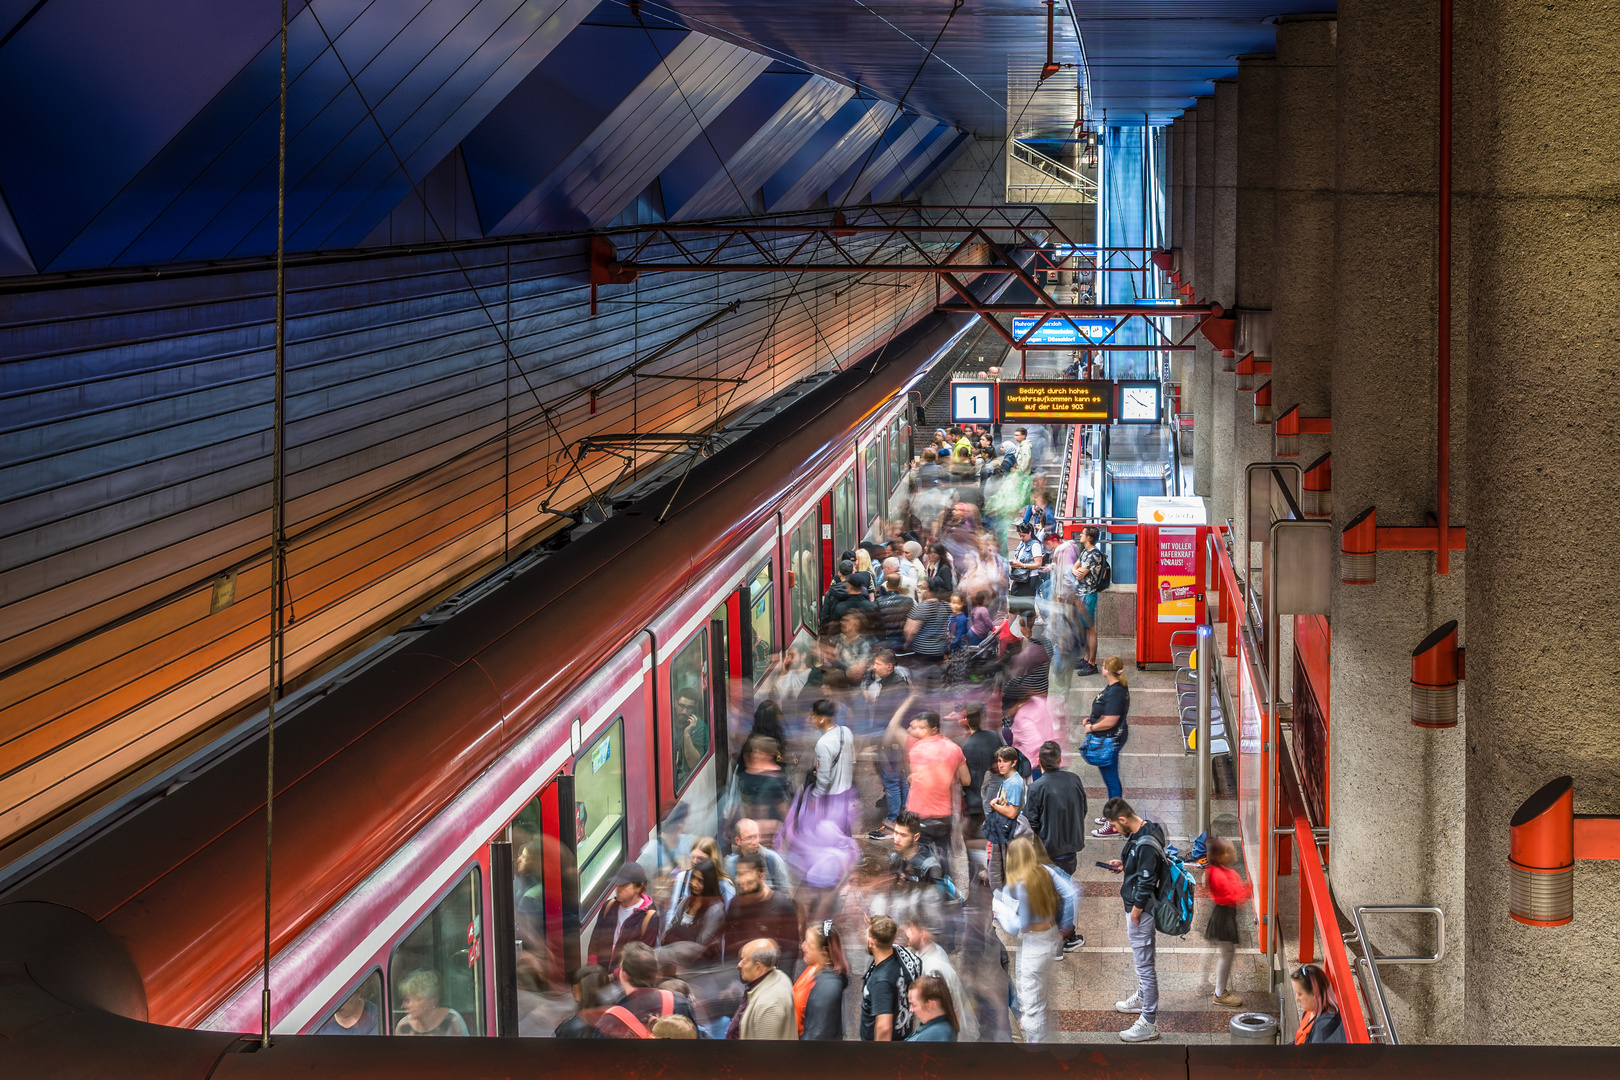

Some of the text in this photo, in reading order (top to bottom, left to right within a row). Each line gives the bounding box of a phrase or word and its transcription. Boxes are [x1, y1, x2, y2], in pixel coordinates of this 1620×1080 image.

[1019, 387, 1045, 395] Bedingt
[1007, 395, 1073, 403] Verkehrsaufkommen
[969, 395, 977, 414] 1
[1024, 403, 1036, 411] auf
[1160, 542, 1192, 550] MIT VOLLER
[1160, 550, 1195, 558] HAFERKRAFT
[1160, 558, 1184, 566] VORAUS!
